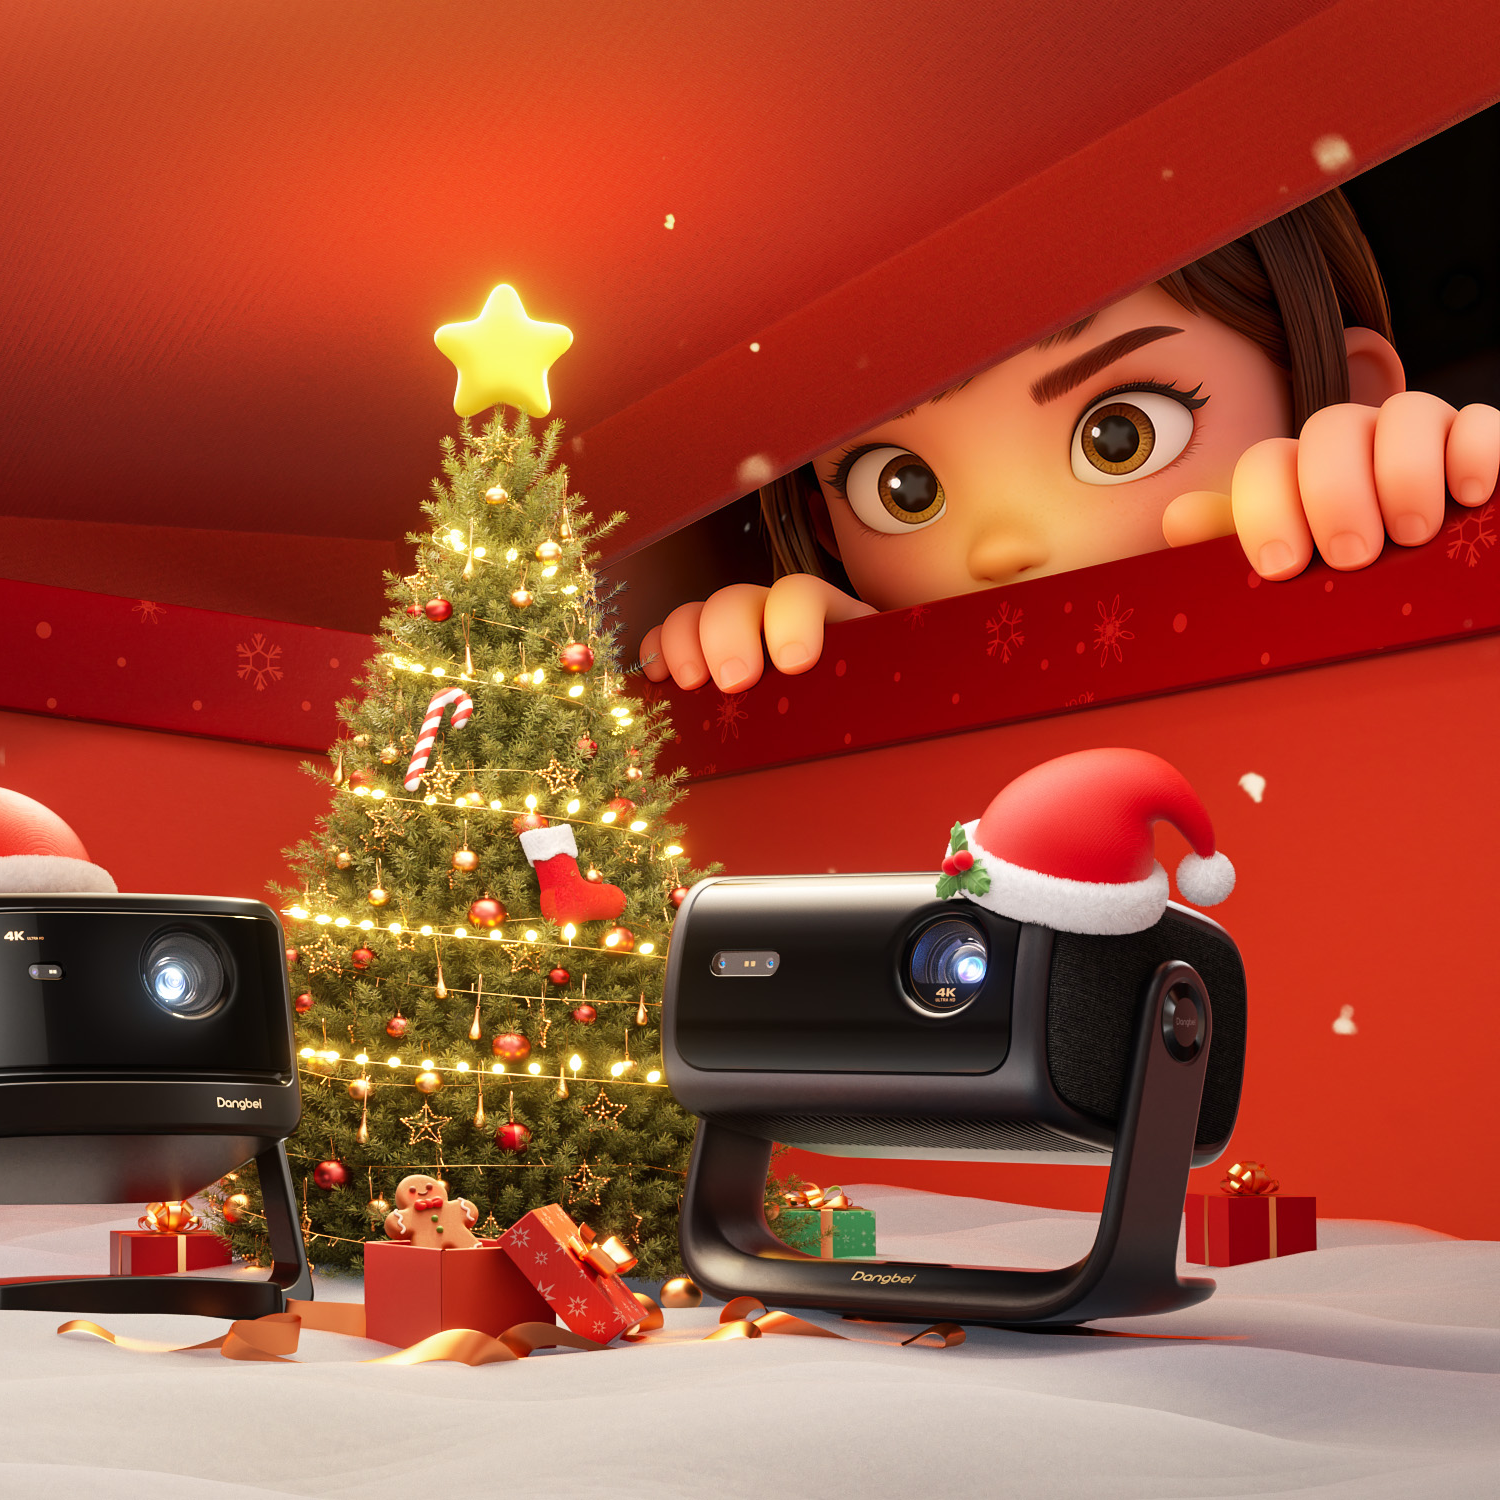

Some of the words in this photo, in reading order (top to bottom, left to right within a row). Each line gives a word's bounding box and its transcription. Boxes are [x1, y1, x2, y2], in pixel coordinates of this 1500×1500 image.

[3, 930, 25, 942] 4K
[935, 987, 957, 998] 4K
[216, 1096, 263, 1111] Dangbei
[851, 1270, 917, 1285] Dangbei
